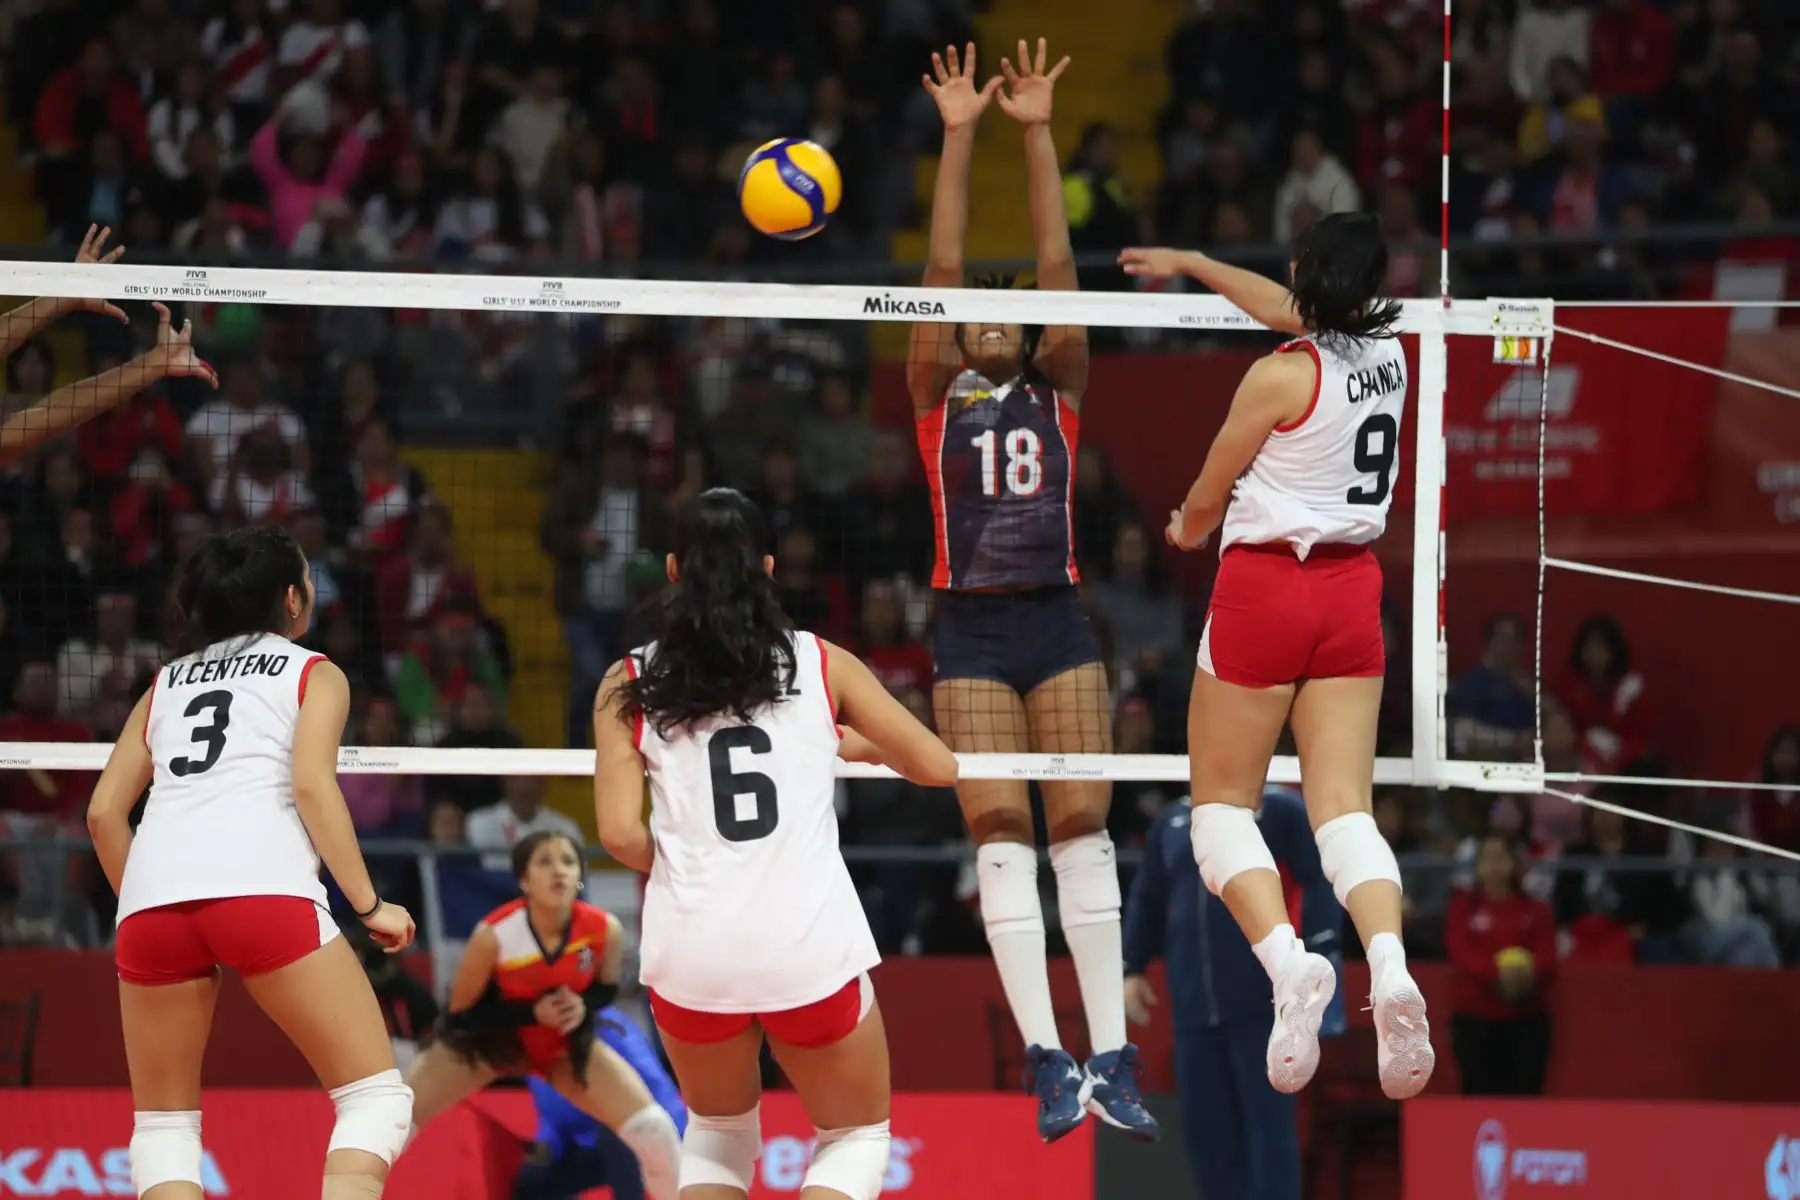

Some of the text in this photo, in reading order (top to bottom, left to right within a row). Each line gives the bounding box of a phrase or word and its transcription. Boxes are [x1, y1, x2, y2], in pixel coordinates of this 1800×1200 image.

[124, 285, 267, 298] GIRLS' U17 WORLD CHAMPIONSHIP
[186, 270, 207, 279] FIVB
[542, 281, 563, 290] FIVB
[482, 296, 622, 308] GIRLS' U17 WORLD CHAMPIONSHIP
[1223, 316, 1250, 324] WORLD
[1347, 358, 1404, 403] CHANCA
[970, 427, 1044, 496] 18
[1347, 413, 1397, 505] 9
[168, 653, 289, 688] V.CENTENO
[169, 689, 233, 777] 3
[708, 725, 779, 842] 6
